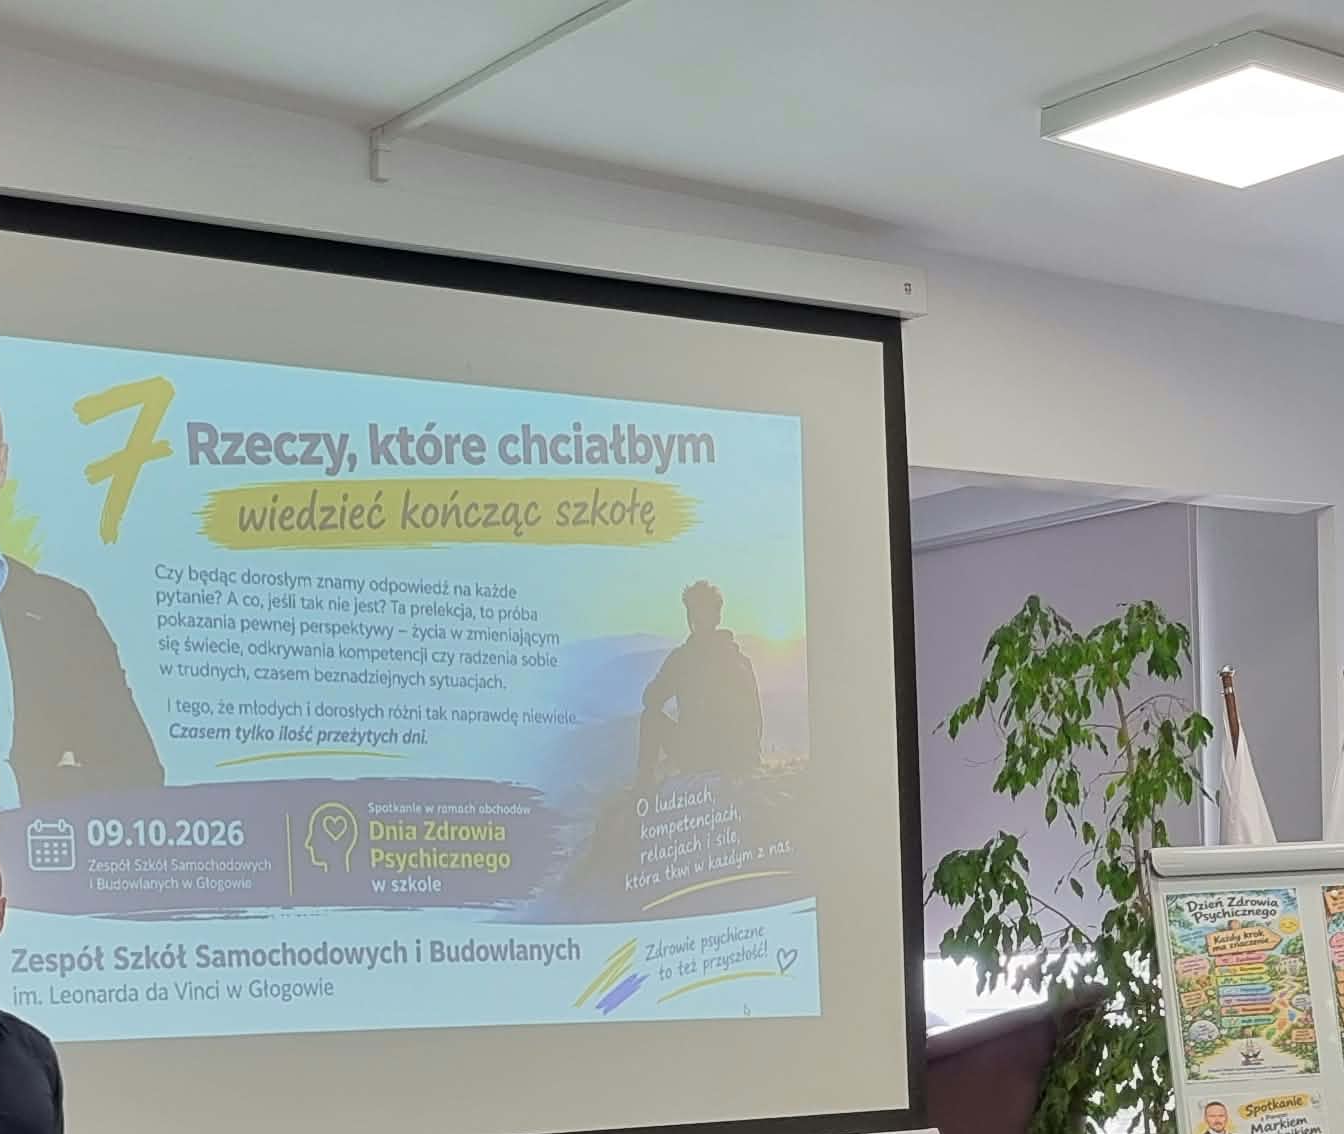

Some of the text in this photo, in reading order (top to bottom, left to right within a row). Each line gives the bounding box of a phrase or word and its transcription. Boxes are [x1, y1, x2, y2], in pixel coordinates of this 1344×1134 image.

[73, 375, 175, 545] 7
[187, 421, 716, 474] Rzeczy, które chciałbym
[238, 488, 656, 537] wiedzieć kończąc szkołę
[155, 563, 517, 599] Czy będąc dorosłym znamy odpowiedź na każde
[156, 589, 538, 623] pytanie? A co, jeśli tak nie jest? Ta prelekcja, to próba
[157, 612, 560, 648] pokazania pewnej perspektywy życia w zmieniającym
[158, 636, 558, 668] się świecie, odkrywania kompetencji czy radzenia sobie
[159, 662, 507, 693] w trudnych, czasem beznadziejnych sytuacjach.
[176, 699, 214, 717] tego,
[217, 698, 235, 715] że
[239, 701, 303, 720] młodych
[314, 703, 384, 722] dorosłych
[388, 704, 422, 721] różni
[426, 706, 449, 721] tak
[451, 707, 519, 727] naprawdę
[168, 722, 428, 747] Czasem tylko ilość przeżytych dni.
[367, 802, 531, 815] Spotkanie w ramach obchodów
[636, 783, 716, 816] O ludziach,
[87, 819, 245, 847] 09.10.2026
[369, 820, 506, 841] Dnia Zdrowia
[639, 803, 743, 841] kompetencjach,
[370, 847, 512, 873] Psychicznego
[640, 833, 702, 865] relacjach
[88, 858, 272, 874] Zespół Szkół Samochodowych
[624, 871, 661, 891] która
[694, 863, 705, 874] w
[757, 847, 765, 859] z
[96, 876, 178, 892] Budowlanych
[181, 879, 193, 889] w
[196, 876, 252, 892] Głogowie
[371, 874, 442, 893] w szkole
[1186, 896, 1279, 914] Dzień Zdrowia
[1192, 908, 1277, 925] Psychicznego
[11, 936, 581, 977] Zespół Szkół Samochodowych i Budowlanych
[645, 926, 766, 962] Zdrowie psychiczne
[659, 943, 769, 981] to też przyszłość!
[12, 978, 335, 1006] im. Leonarda da Vinci w Głogowie
[1244, 1096, 1304, 1117] Spotkanie
[1250, 1117, 1308, 1134] Markiem
